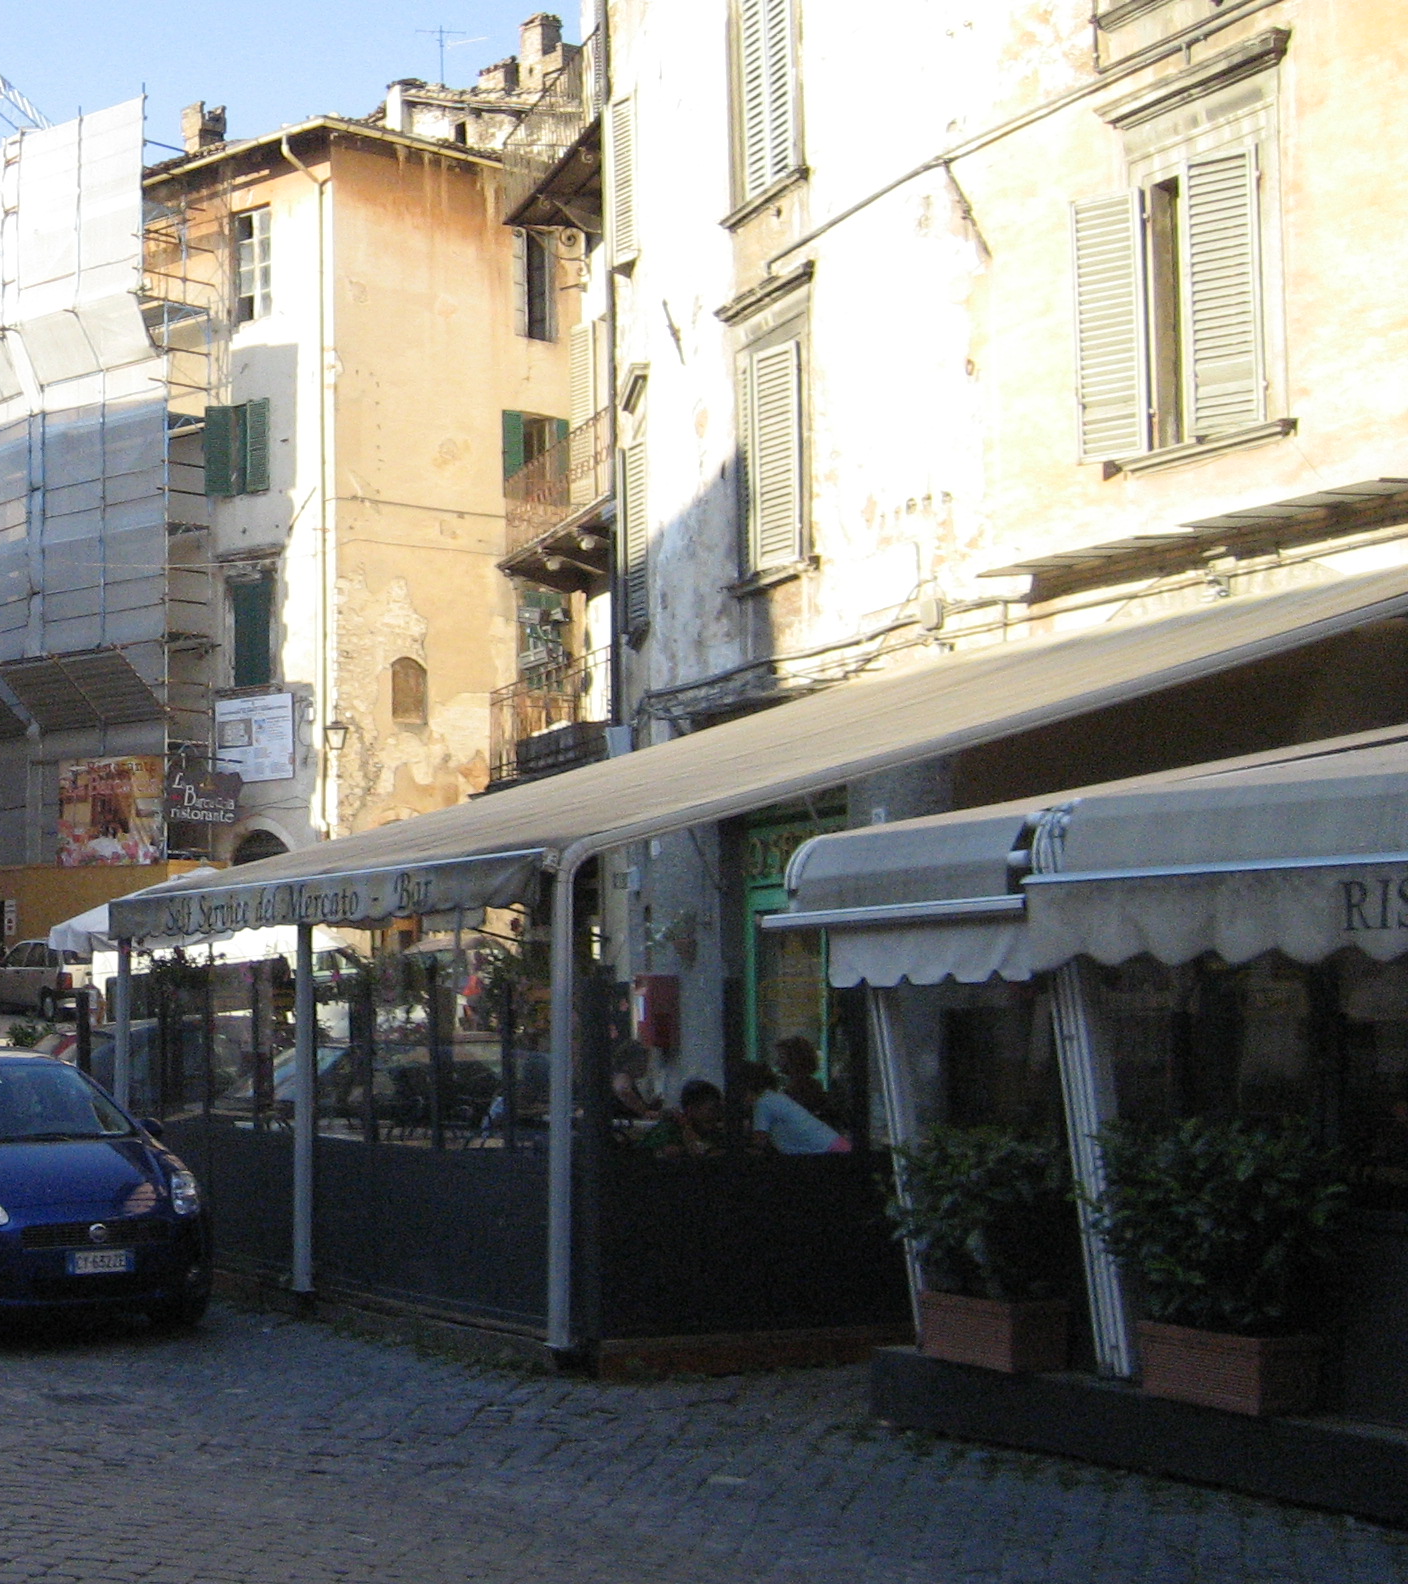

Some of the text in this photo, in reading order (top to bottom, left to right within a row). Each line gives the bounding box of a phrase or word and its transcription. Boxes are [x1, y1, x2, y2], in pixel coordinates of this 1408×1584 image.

[198, 895, 250, 929] Service
[255, 886, 277, 923] del
[282, 883, 359, 926] Mercato
[393, 871, 433, 911] Bar
